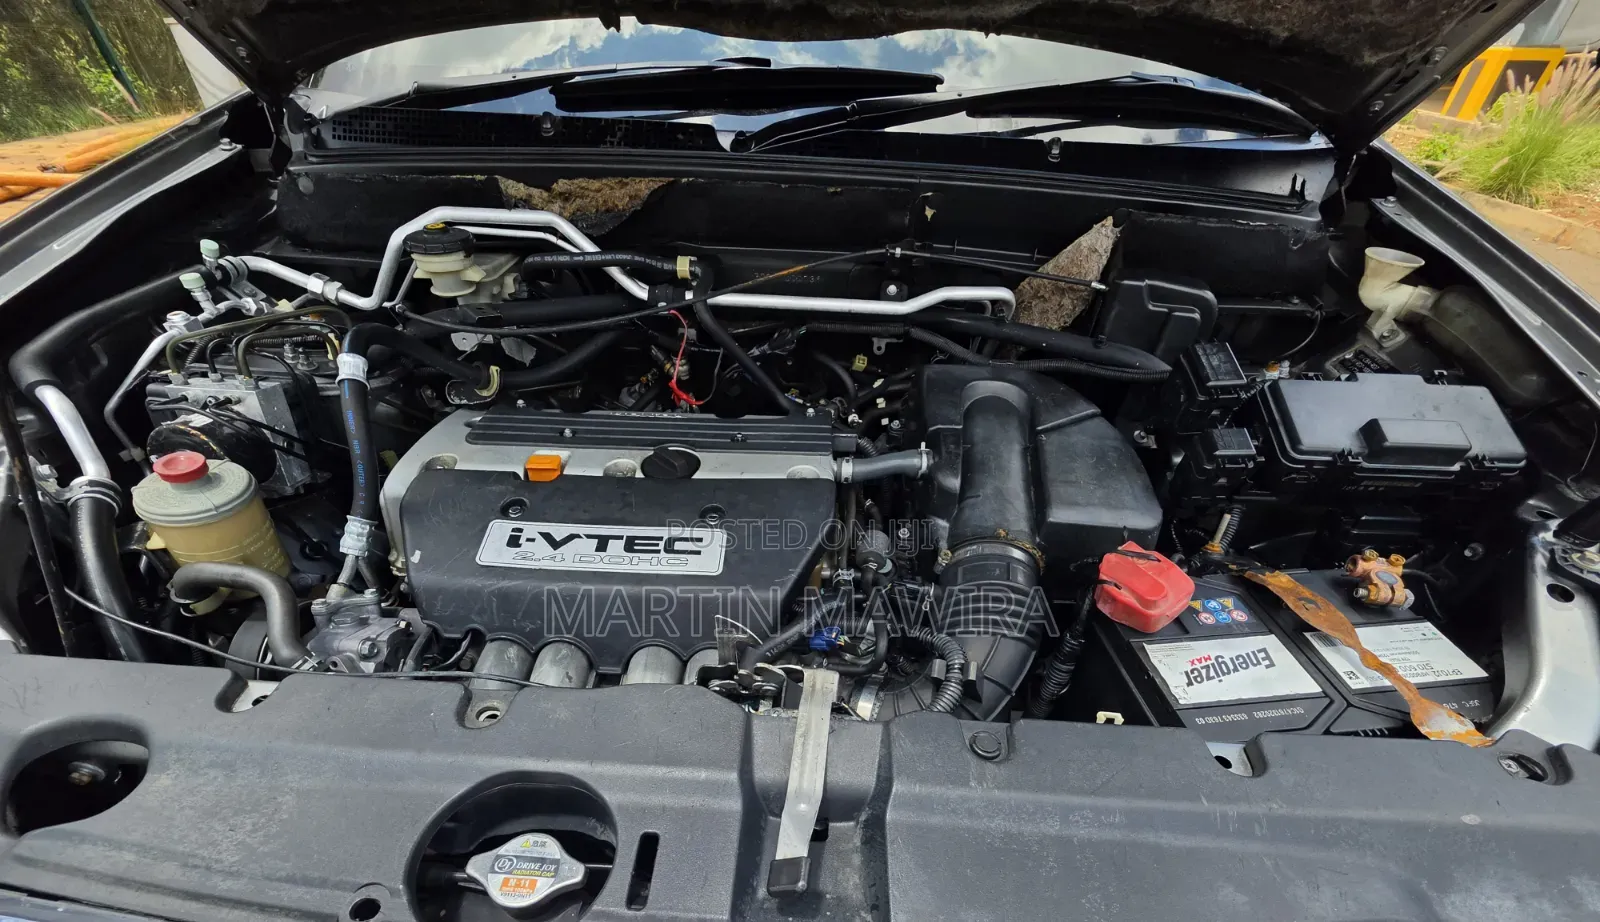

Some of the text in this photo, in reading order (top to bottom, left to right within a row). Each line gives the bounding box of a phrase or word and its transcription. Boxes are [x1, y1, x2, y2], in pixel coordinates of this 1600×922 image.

[506, 527, 704, 556] i-VTEC
[512, 551, 688, 566] 2.4 DOHC
[1184, 647, 1276, 687] Energizer
[1191, 654, 1212, 667] MAX
